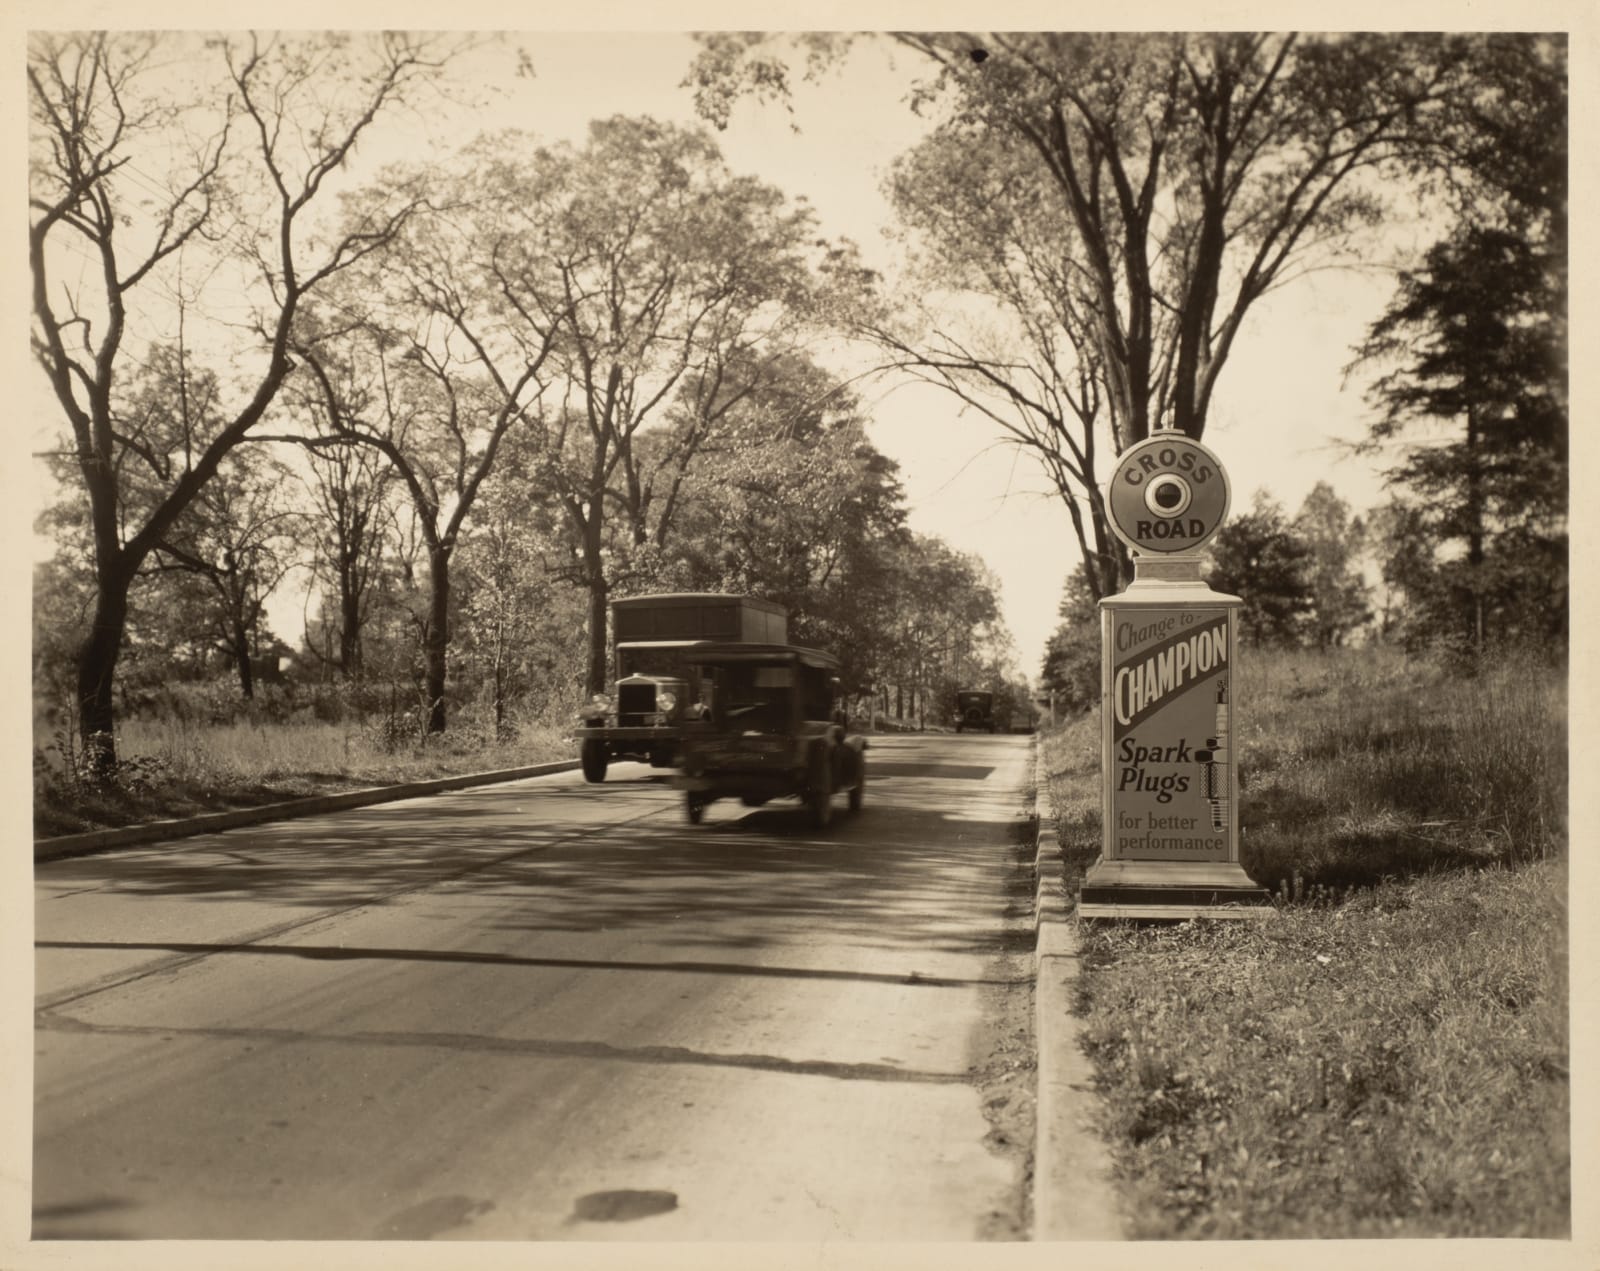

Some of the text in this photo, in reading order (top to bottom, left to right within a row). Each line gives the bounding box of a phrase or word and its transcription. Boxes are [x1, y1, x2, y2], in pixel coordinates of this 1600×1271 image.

[1124, 448, 1213, 486] CROSS
[1137, 519, 1205, 539] ROAD
[1116, 617, 1175, 652] Change
[1114, 623, 1227, 726] CHAMPION
[1118, 738, 1193, 768] Spark
[1117, 767, 1190, 804] Plugs
[1118, 808, 1198, 830] for better
[1119, 831, 1224, 853] performance
